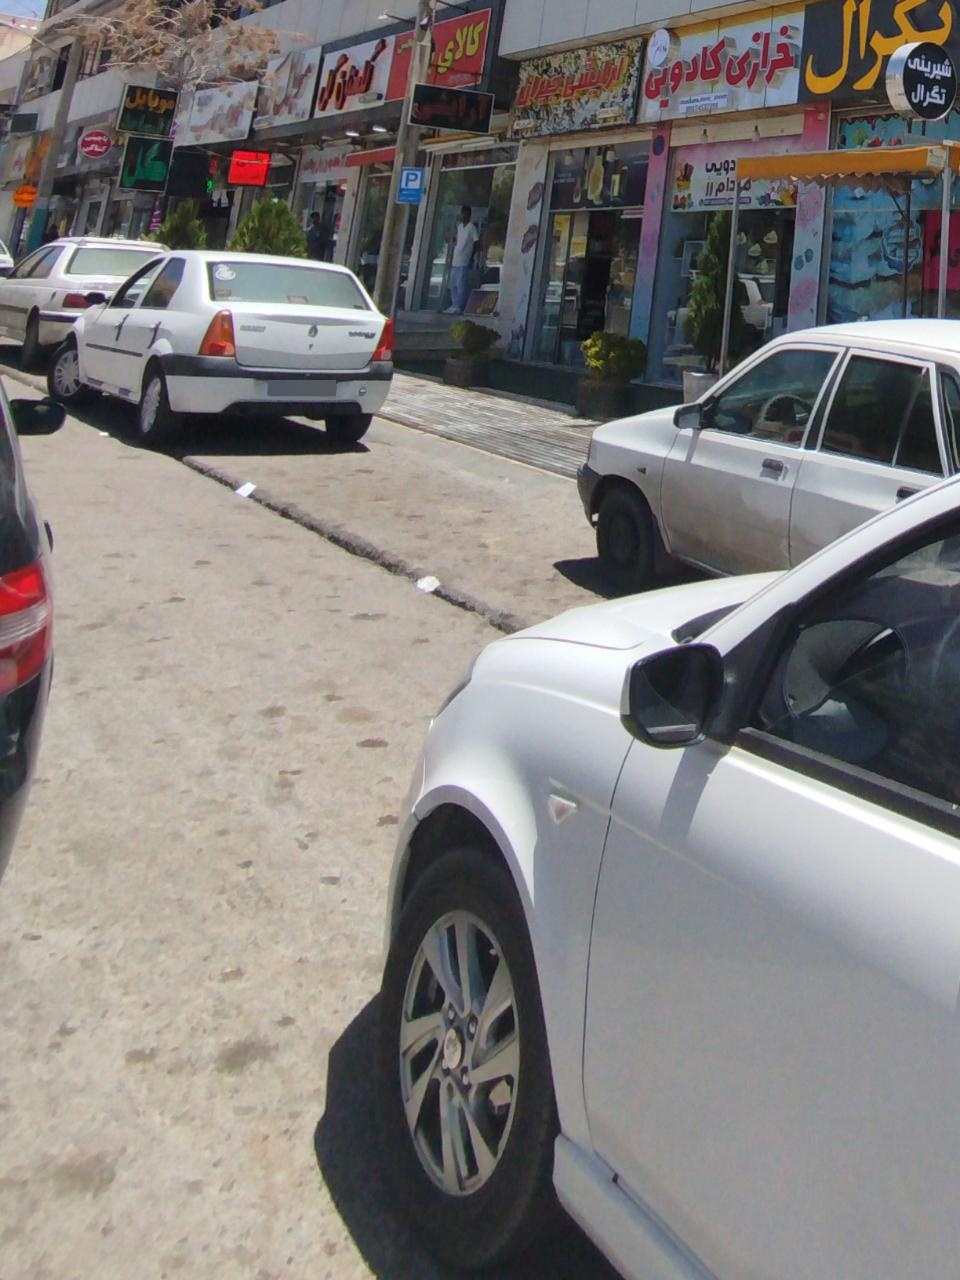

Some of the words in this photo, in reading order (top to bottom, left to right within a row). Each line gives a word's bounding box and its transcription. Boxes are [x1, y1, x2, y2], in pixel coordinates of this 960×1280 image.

[726, 24, 795, 89] خرازی
[907, 55, 953, 80] شیرینی
[645, 38, 727, 109] کادویی
[910, 84, 946, 107] تگرال
[405, 172, 419, 187] P
